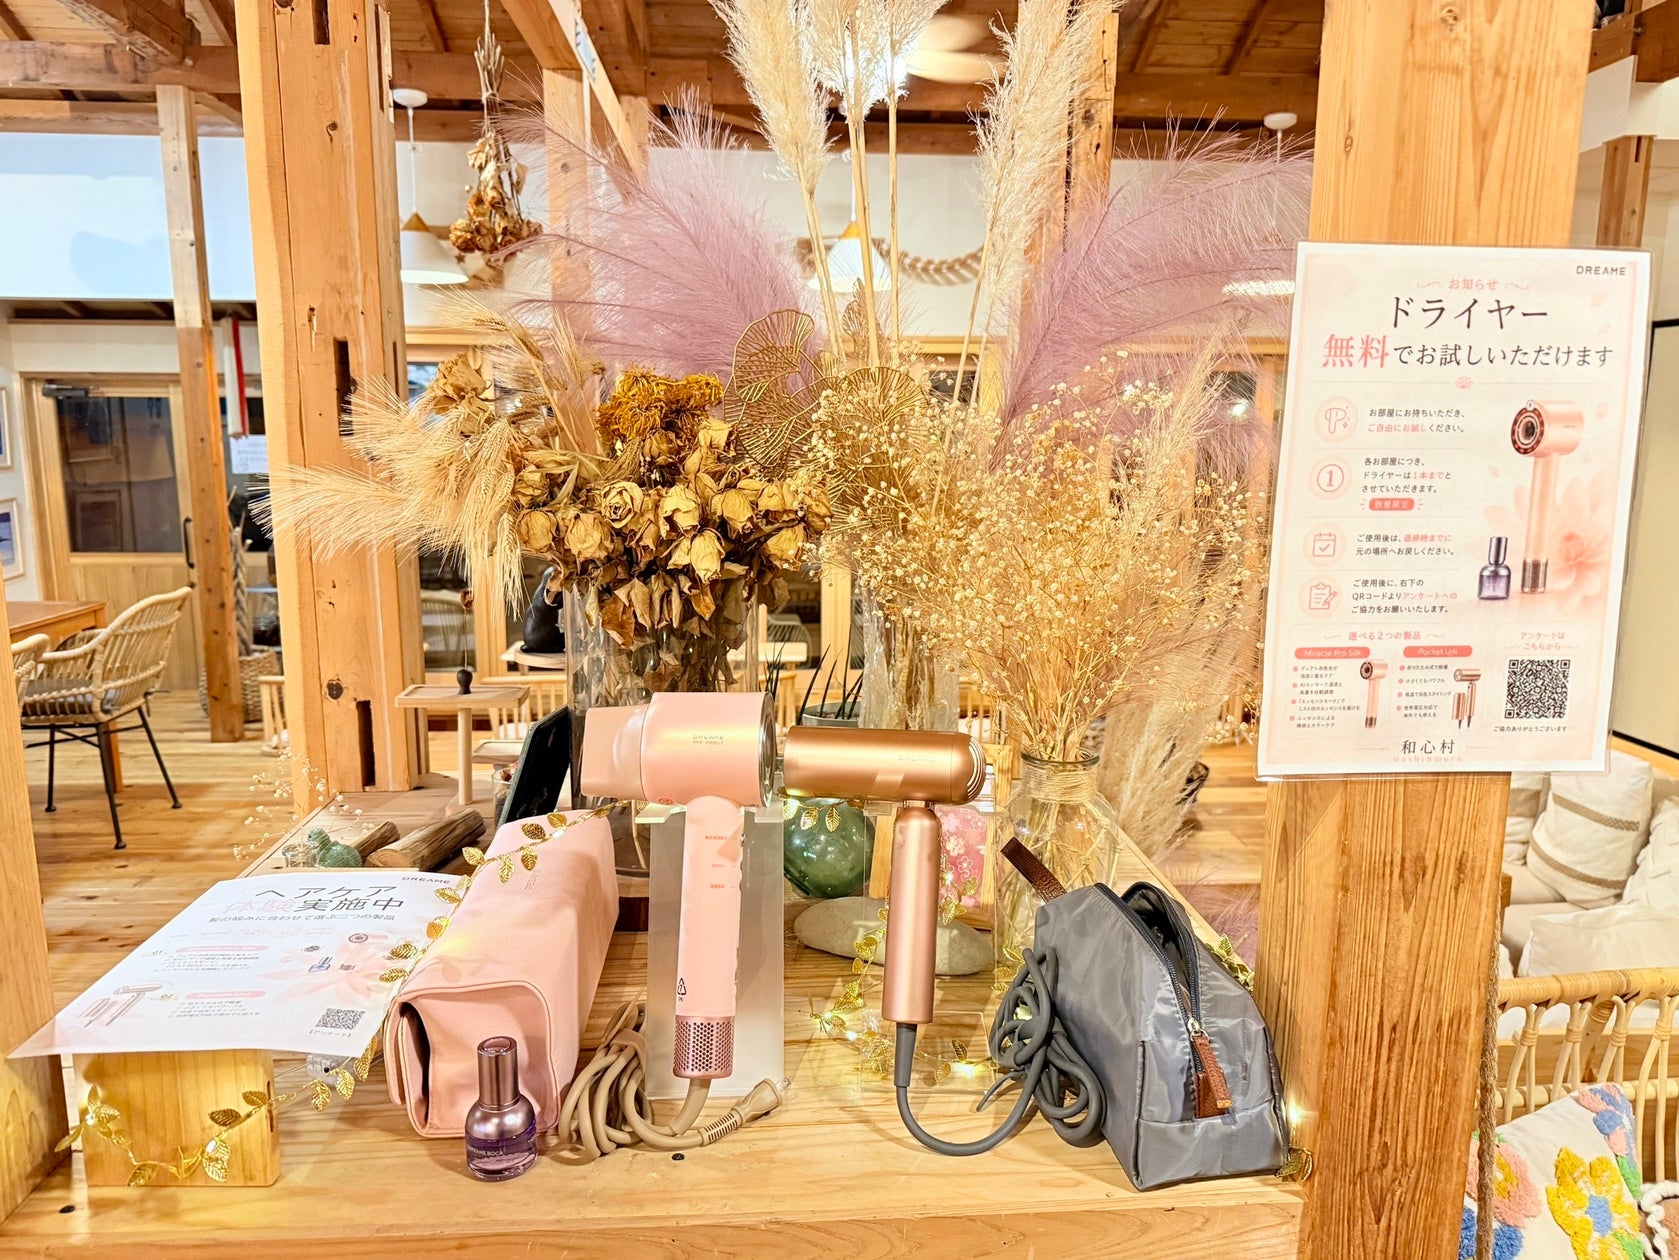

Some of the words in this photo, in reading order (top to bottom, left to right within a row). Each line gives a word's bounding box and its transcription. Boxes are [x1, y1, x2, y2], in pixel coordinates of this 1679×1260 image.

[1576, 265, 1626, 276] DREAME
[1448, 277, 1498, 291] お知らせ
[1391, 296, 1548, 330] ドライヤー
[1322, 334, 1614, 369] 無料でお試しいただけます
[1369, 408, 1465, 418] お部屋にお持ちいただき、
[1367, 423, 1464, 433] ご自由にお試しください。
[1364, 457, 1425, 467] 各お部屋につき、
[1361, 484, 1438, 494] させていただきます。
[1355, 547, 1455, 556] 元の場所へお戻しください。
[1353, 579, 1424, 588] ご使用後に、右下の
[1351, 605, 1449, 614] ご協力をお願いいたします。
[1520, 631, 1565, 640] アンケートは
[1522, 642, 1561, 651] こちらから
[1334, 649, 1347, 657] Pro
[1348, 648, 1362, 656] Silk
[1418, 648, 1443, 656] Pocket
[1401, 739, 1456, 755] 和心村
[402, 876, 451, 885] DREAME
[255, 885, 398, 900] ヘアケア
[223, 897, 405, 912] 体験実施中
